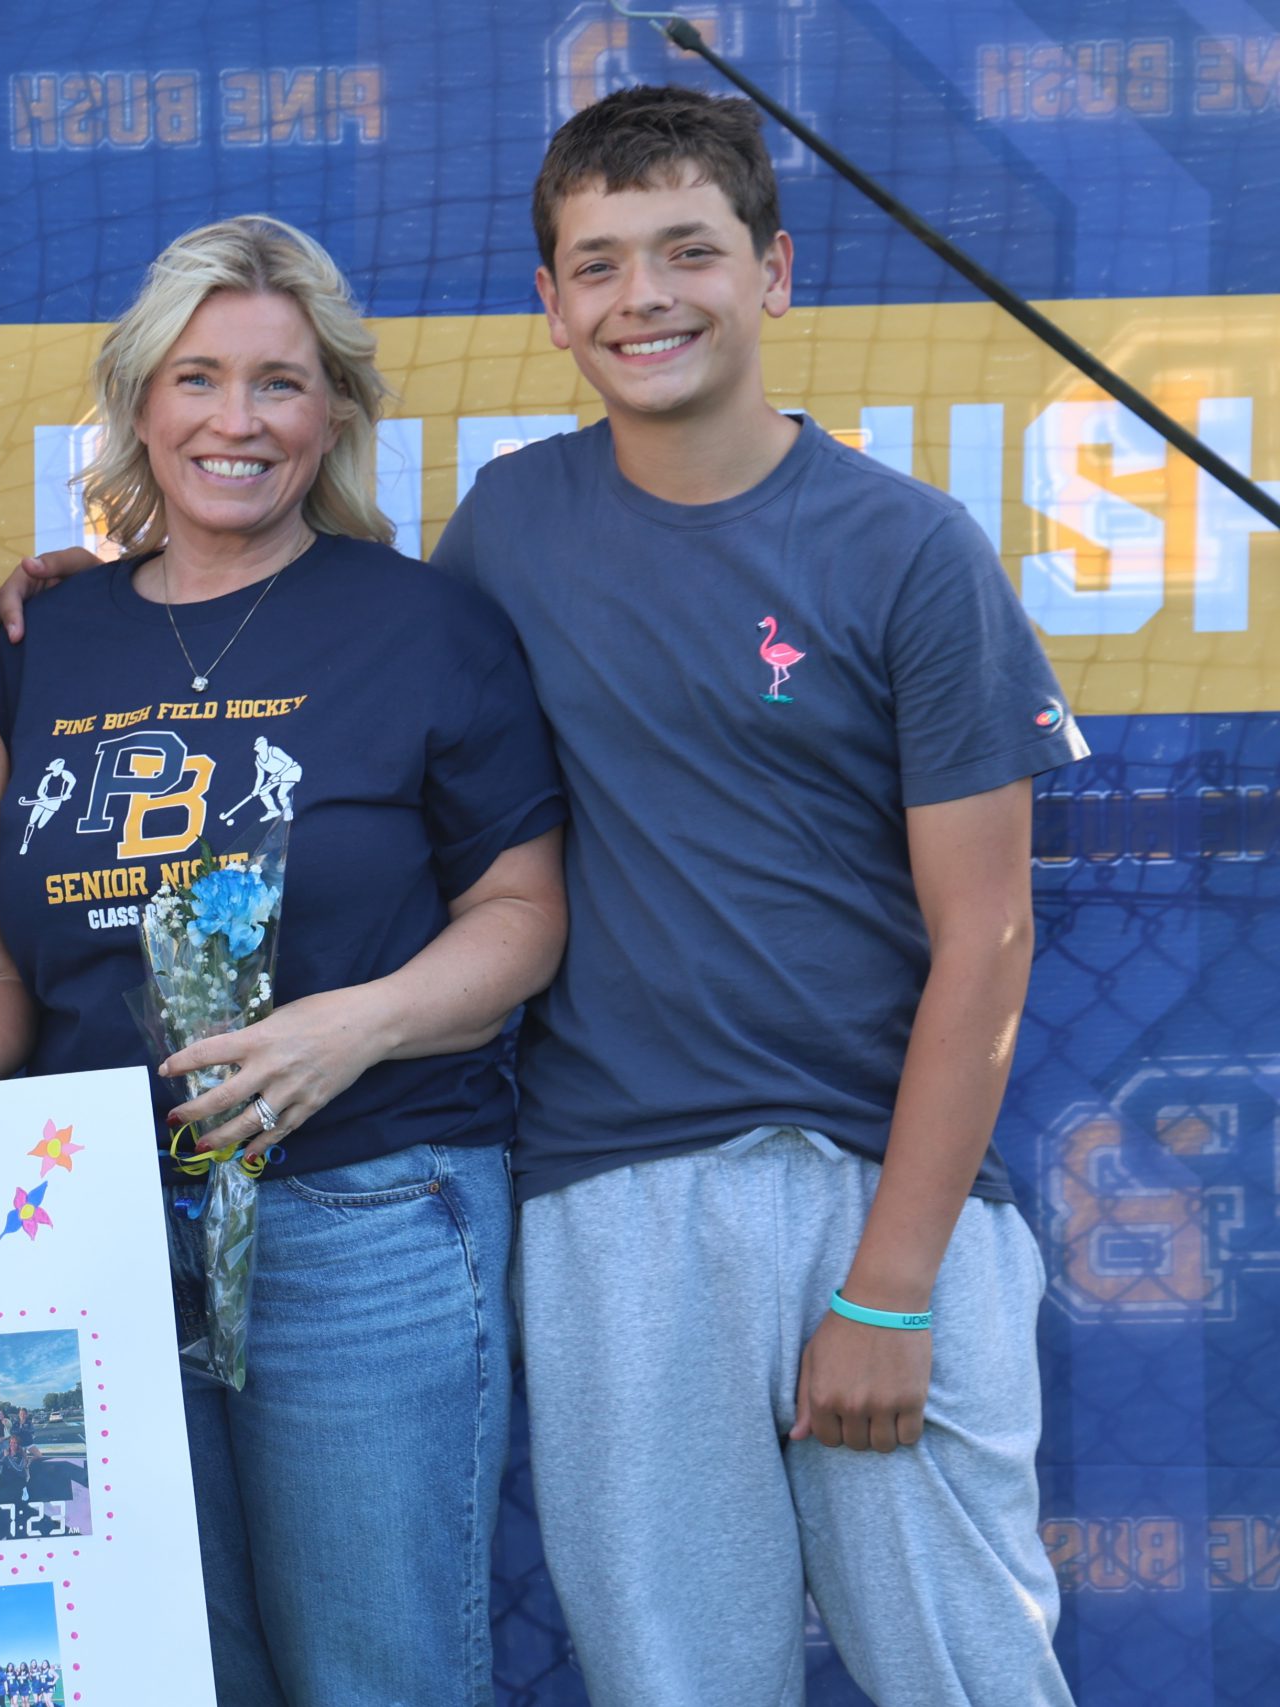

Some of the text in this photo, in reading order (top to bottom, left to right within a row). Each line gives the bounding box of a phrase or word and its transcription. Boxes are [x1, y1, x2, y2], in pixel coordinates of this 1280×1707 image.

[52, 694, 308, 736] PINE BUSH FIELD HOCKEY
[76, 730, 216, 859] PB
[45, 866, 148, 904] SENIOR
[88, 905, 139, 930] CLASS
[0, 1500, 81, 1537] 7:23 AM
